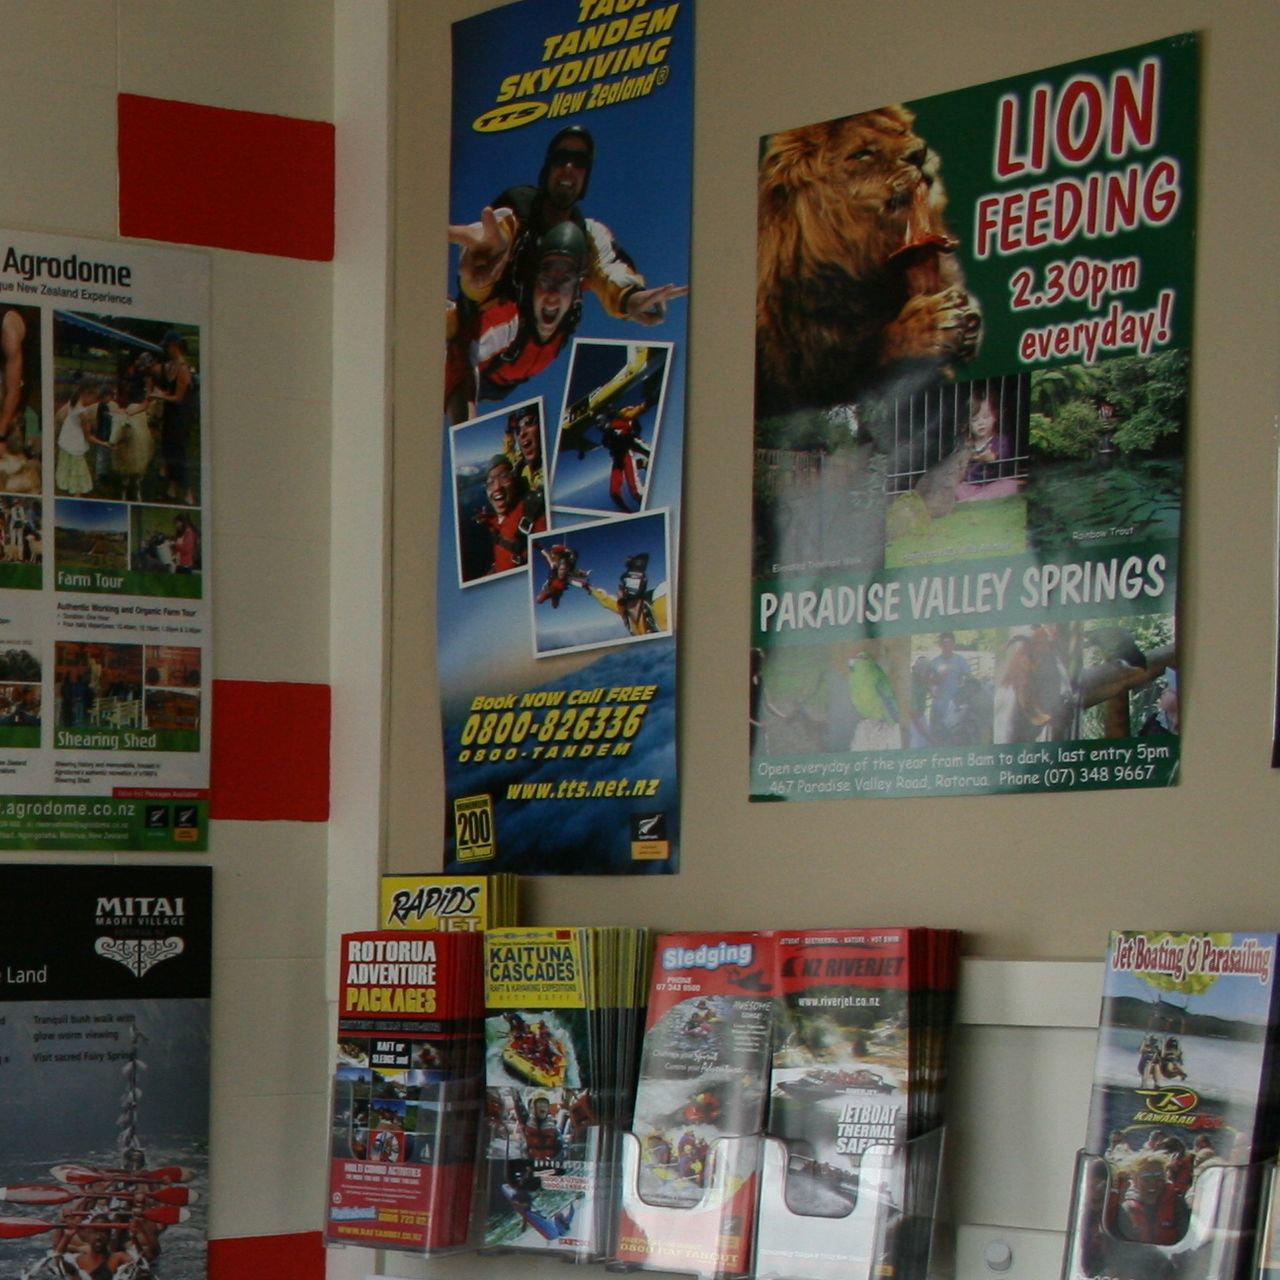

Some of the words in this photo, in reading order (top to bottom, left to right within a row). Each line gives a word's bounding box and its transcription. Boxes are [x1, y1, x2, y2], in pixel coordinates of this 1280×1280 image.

[542, 4, 680, 62] TANDEM
[496, 37, 672, 103] SKYDIVING
[479, 104, 542, 128] TTS
[548, 91, 588, 119] New
[996, 61, 1157, 177] LION
[974, 160, 1178, 258] FEEDING
[2, 247, 132, 288] Agrodome
[17, 282, 38, 295] New
[40, 283, 79, 299] Zealand
[80, 288, 133, 306] Experience
[1009, 258, 1138, 310] 2.30pm
[1019, 291, 1172, 364] everyday!
[1109, 526, 1134, 537] Trout
[57, 571, 91, 587] Farm
[94, 574, 125, 589] Tour
[759, 582, 900, 633] PARADISE
[907, 567, 1012, 621] VALLEY
[1021, 552, 1167, 611] SPRINGS
[470, 692, 518, 711] Book
[519, 690, 567, 708] NOW
[567, 687, 604, 706] Call
[605, 684, 657, 704] FREE
[460, 703, 649, 747] 0800-826336
[57, 730, 119, 750] Shearing
[123, 731, 157, 749] Shed
[758, 762, 791, 779] Open
[792, 761, 852, 777] everyday
[853, 757, 870, 772] of
[872, 758, 896, 772] the
[897, 757, 927, 774] year
[931, 754, 964, 769] from
[968, 752, 995, 768] 8am
[999, 751, 1013, 766] to
[1058, 748, 1085, 763] last
[1090, 747, 1133, 765] entry
[1137, 743, 1169, 762] 5pm
[506, 777, 662, 800] www.tts.net.nz
[769, 779, 794, 794] 467
[797, 778, 851, 793] Paradise
[855, 778, 892, 793] Valley
[1000, 770, 1040, 786] Phone
[1044, 768, 1075, 787] (07)
[1081, 767, 1110, 783] 348
[1114, 764, 1156, 782] 9667
[457, 808, 491, 847] 200
[95, 897, 185, 916] MITAI
[95, 917, 133, 926] MAORI
[138, 917, 185, 926] VILLAGE
[348, 940, 437, 963] ROTORUA
[490, 946, 574, 963] KAITUNA
[661, 941, 754, 971] Sledging
[1112, 935, 1136, 971] Jet
[1135, 936, 1186, 982] Boating
[1200, 937, 1273, 984] Parasailing
[6, 965, 48, 984] Land
[347, 963, 437, 985] ADVENTURE
[490, 962, 575, 982] CASCADES
[804, 957, 824, 977] NZ
[826, 956, 905, 977] RIVERJET
[346, 987, 437, 1013] PACKAGES
[837, 1103, 900, 1124] JETBOAT
[837, 1124, 896, 1138] THERMAL
